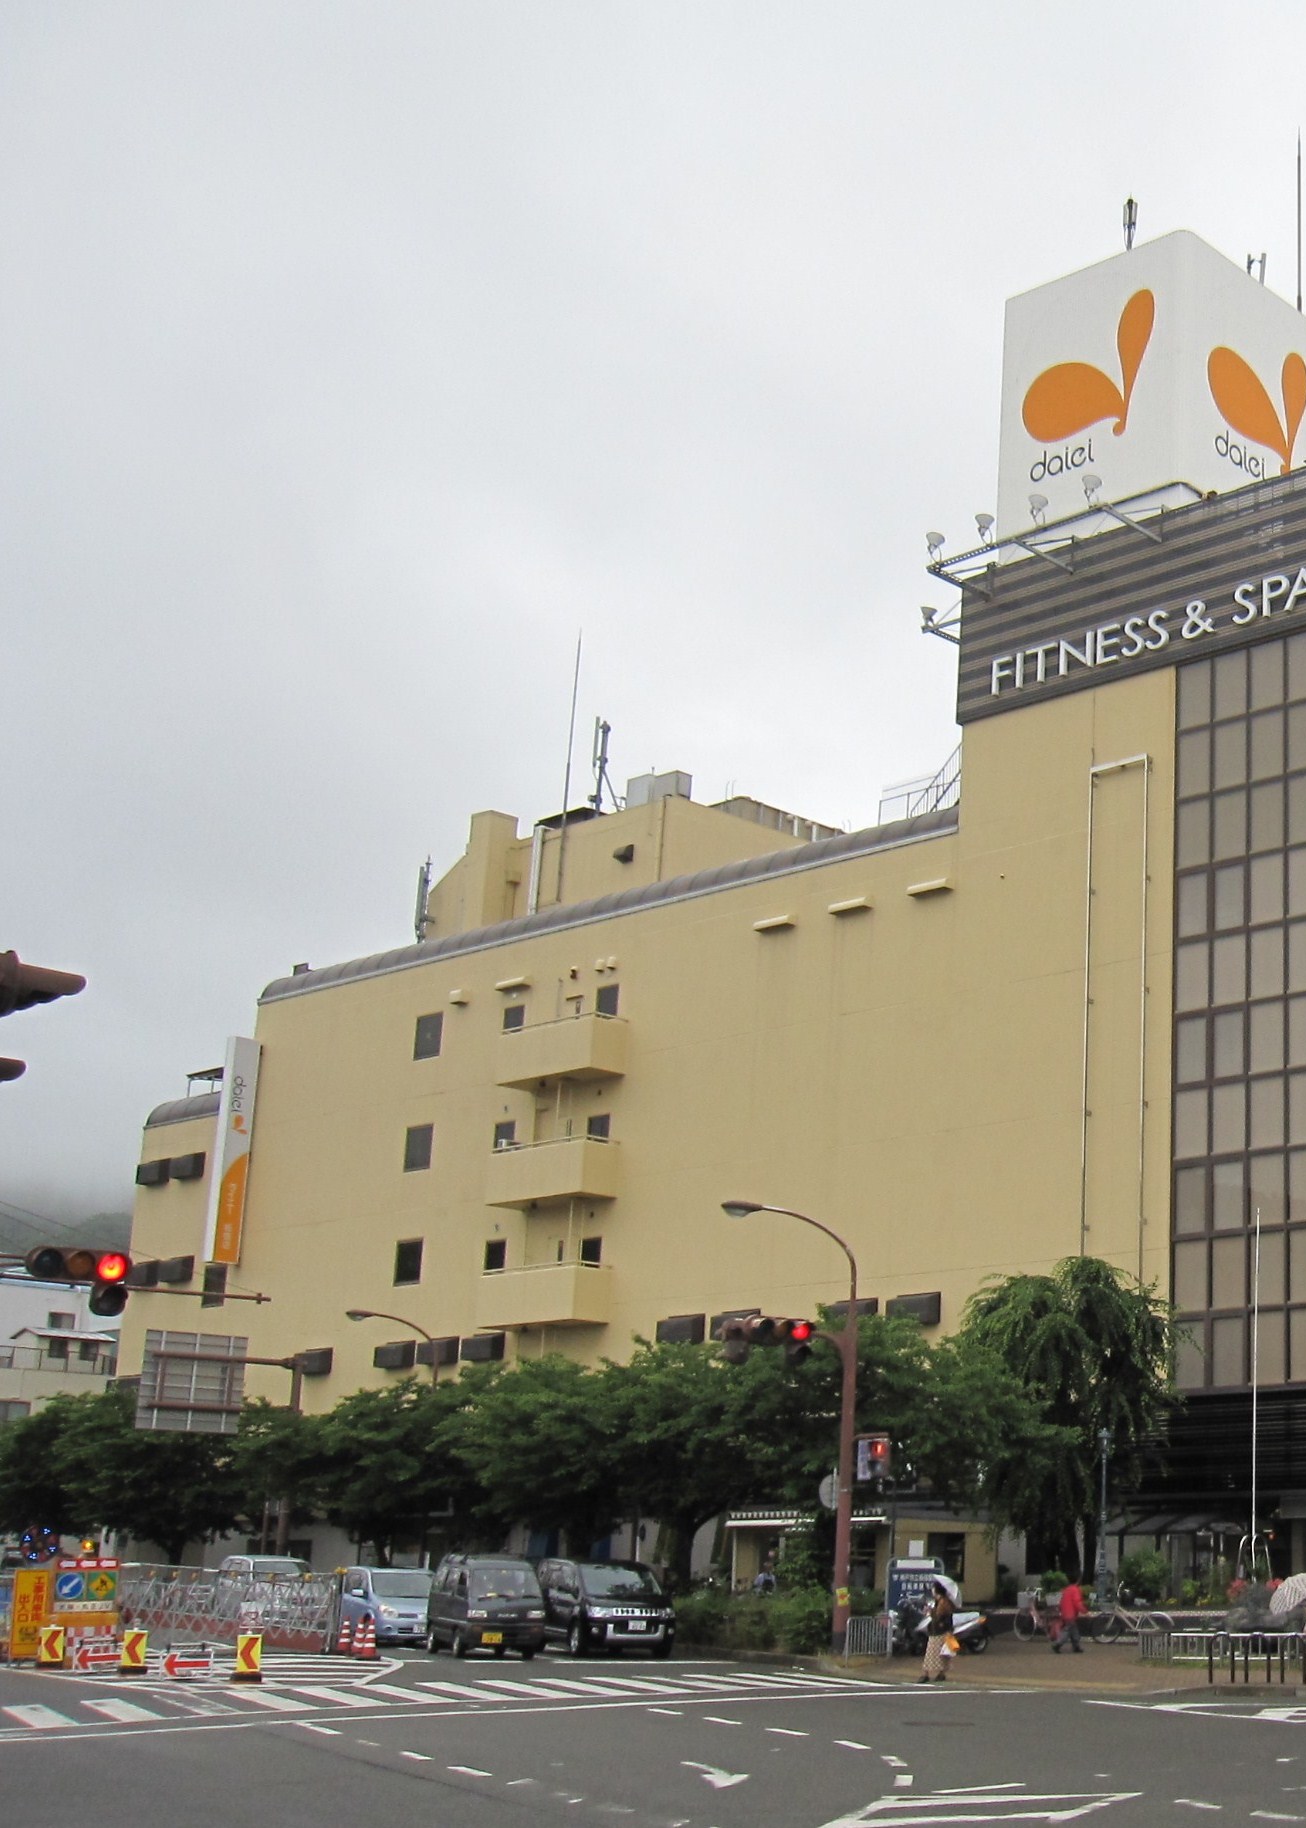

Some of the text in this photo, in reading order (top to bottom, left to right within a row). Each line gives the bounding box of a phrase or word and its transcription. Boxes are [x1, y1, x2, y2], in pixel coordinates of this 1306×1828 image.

[1030, 438, 1094, 482] daiei
[1215, 430, 1266, 480] daiei
[990, 609, 1170, 697] FITNESS
[1181, 600, 1215, 639] &
[231, 1075, 247, 1113] daiei
[17, 1593, 30, 1623] 出入口
